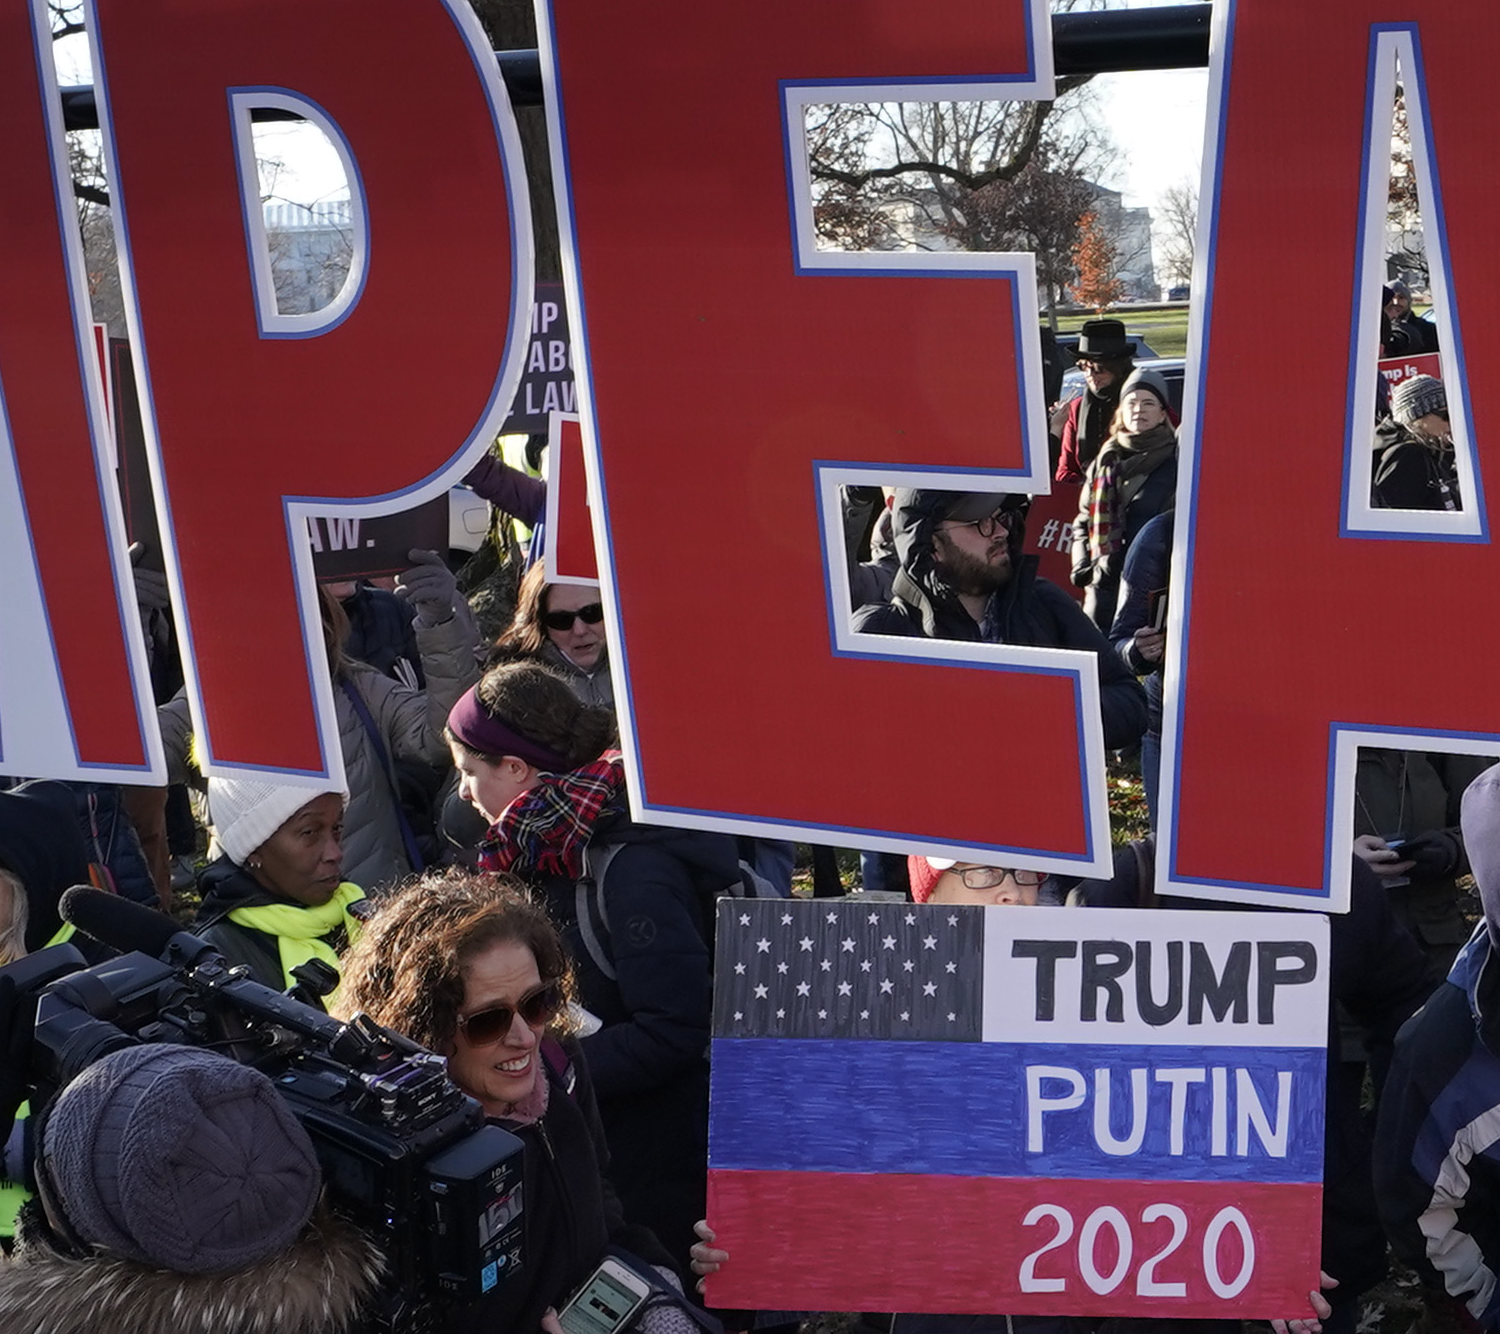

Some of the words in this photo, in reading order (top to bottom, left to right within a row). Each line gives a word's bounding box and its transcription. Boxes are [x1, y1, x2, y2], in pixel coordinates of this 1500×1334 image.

[1012, 940, 1318, 1025] TRUMP
[1025, 1065, 1293, 1158] PUTIN
[1018, 1203, 1256, 1300] 2020
